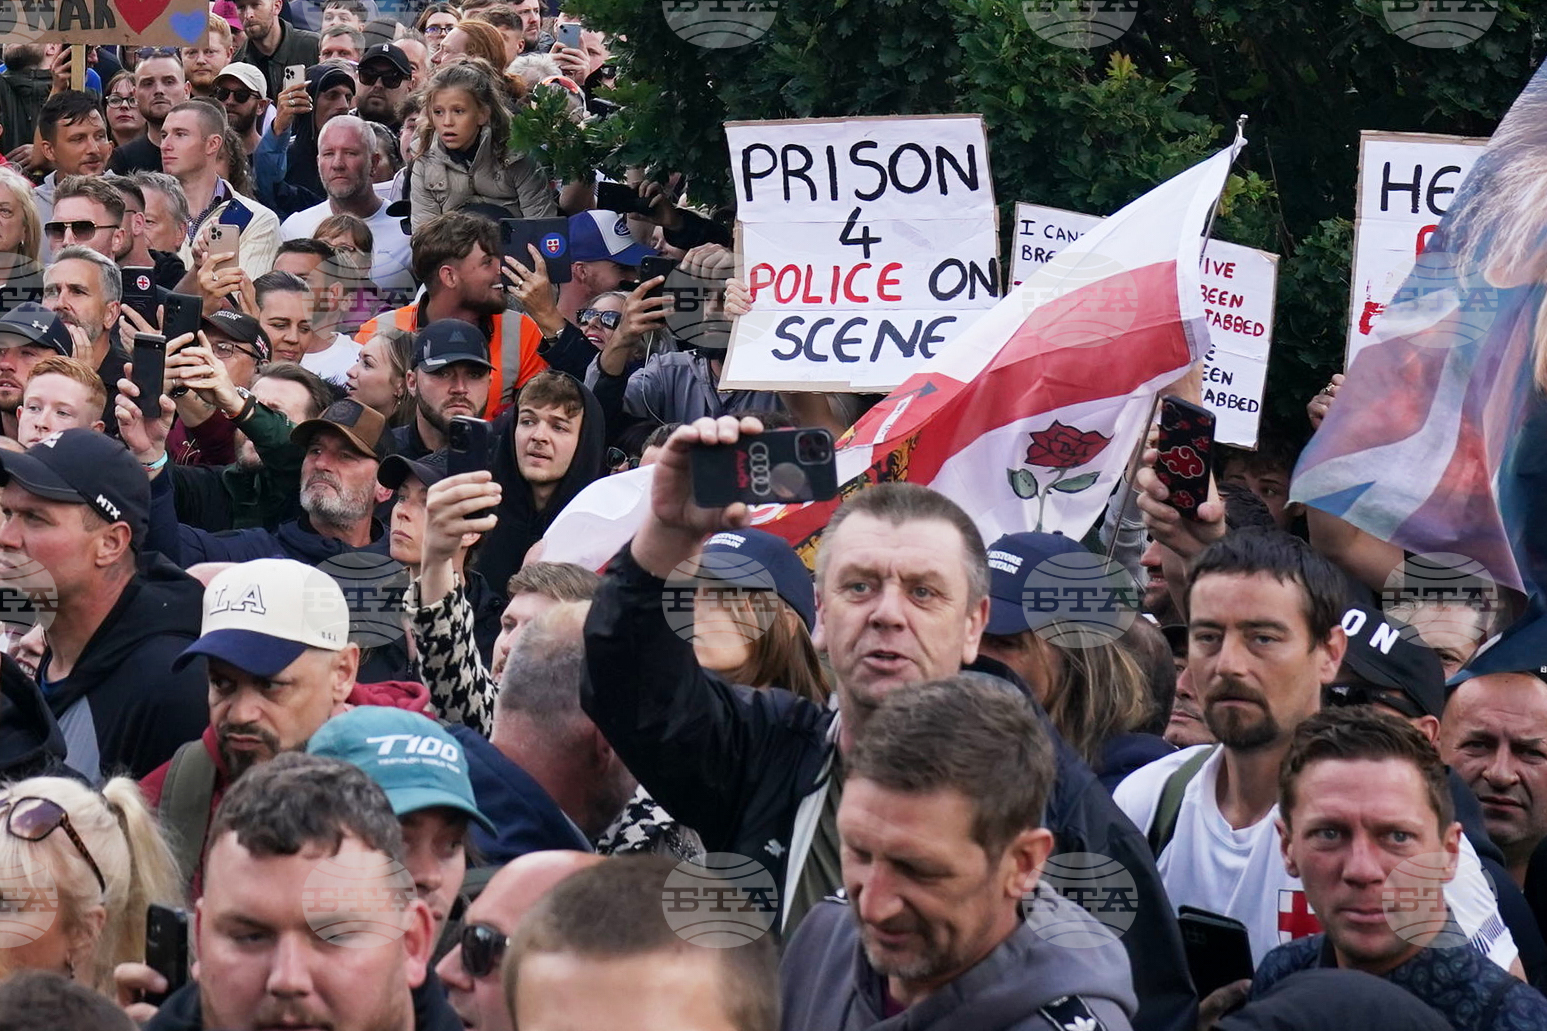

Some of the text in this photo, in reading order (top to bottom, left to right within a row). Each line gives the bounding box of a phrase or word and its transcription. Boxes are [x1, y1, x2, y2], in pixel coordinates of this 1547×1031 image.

[741, 140, 980, 203] PRISON
[839, 206, 882, 259] 4
[1020, 220, 1036, 236] I
[749, 257, 999, 305] POLICE ON
[1205, 308, 1264, 337] TABBED
[771, 315, 957, 362] SCENE
[1203, 387, 1259, 413] ABBED
[96, 493, 121, 520] MTX
[210, 583, 266, 616] LA
[366, 734, 459, 762] T100
